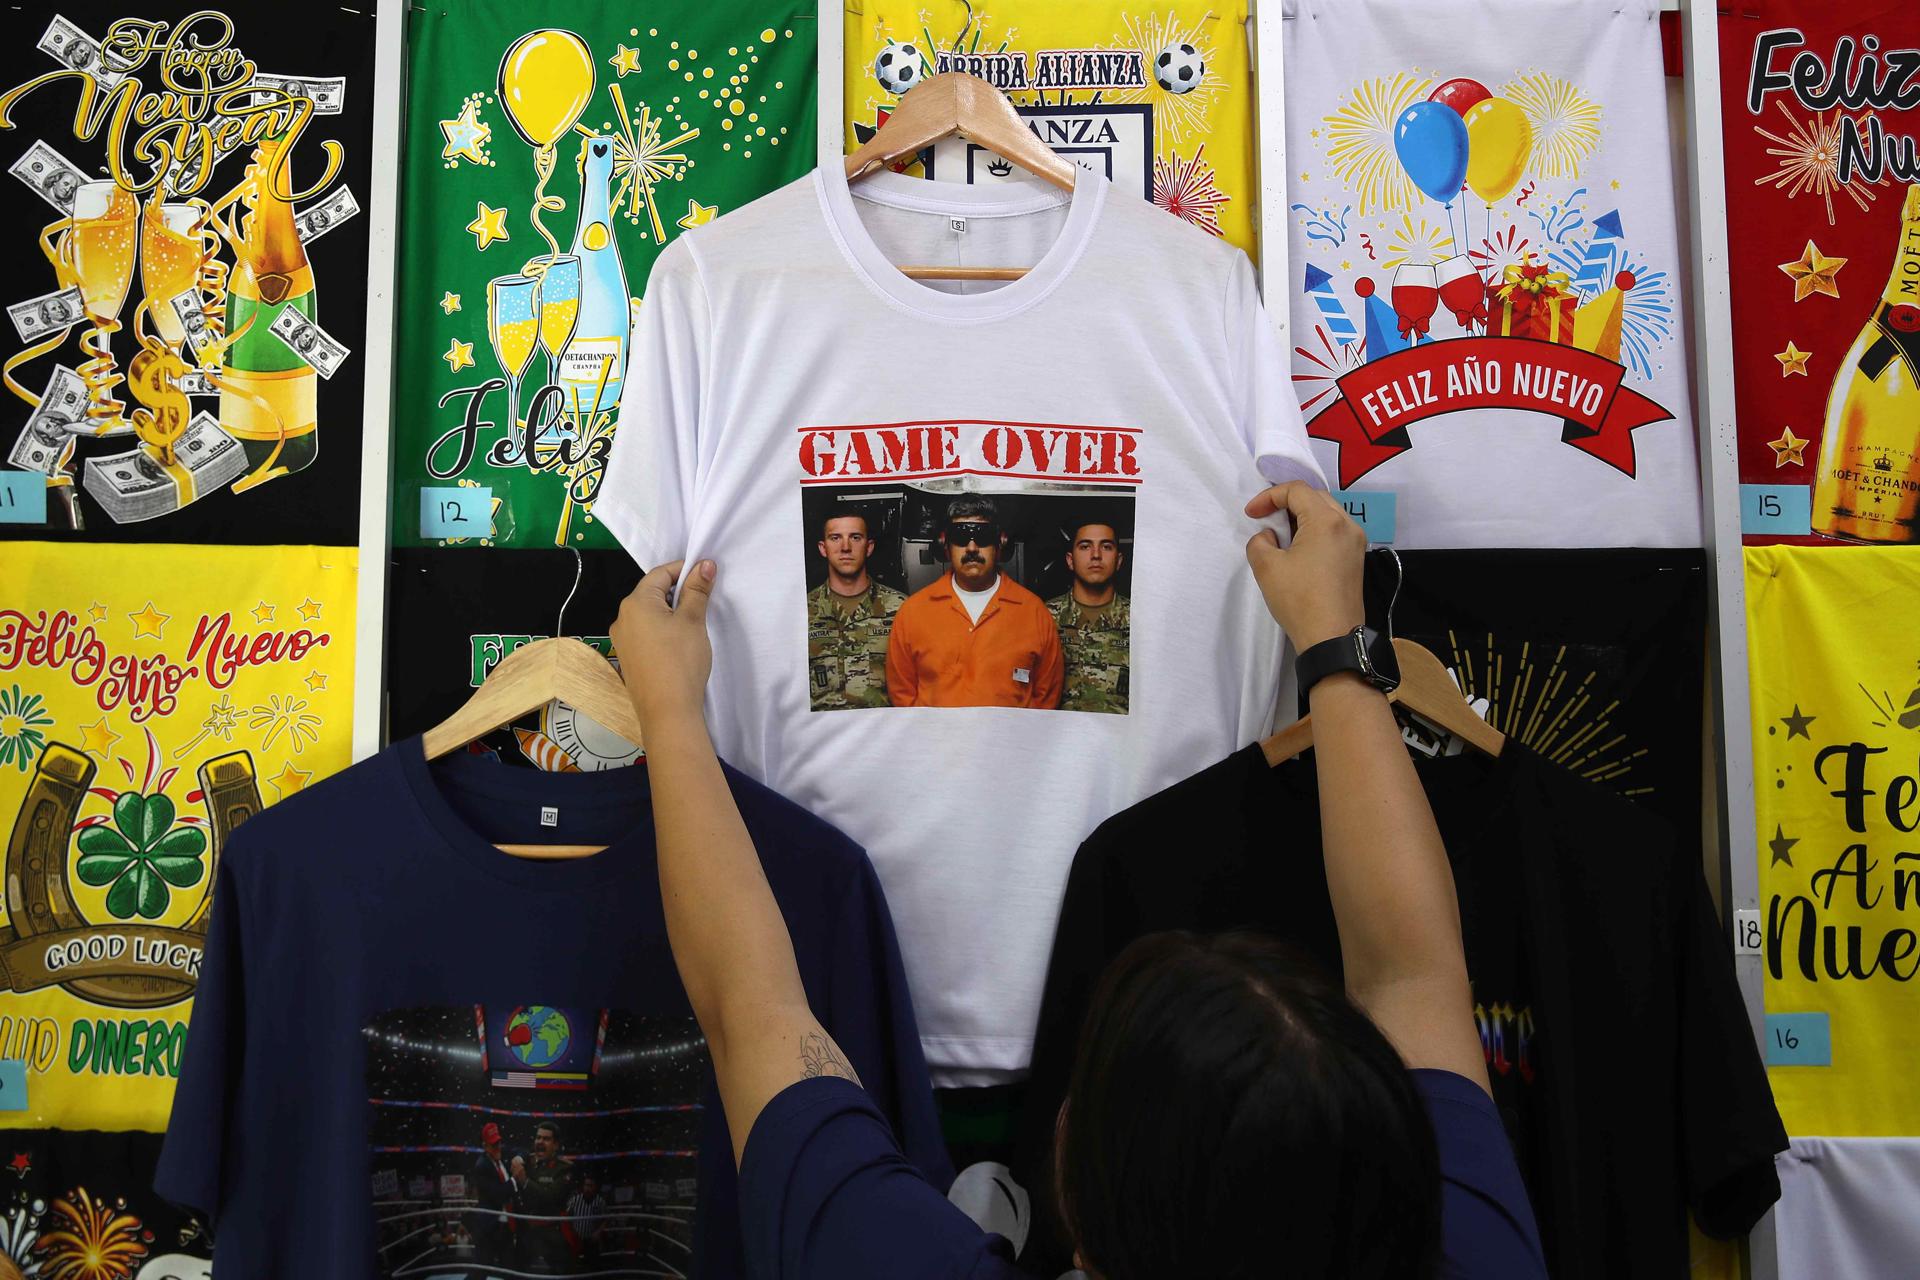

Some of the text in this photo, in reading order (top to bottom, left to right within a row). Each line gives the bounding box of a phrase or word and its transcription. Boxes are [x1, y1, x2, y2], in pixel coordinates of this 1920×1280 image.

[102, 11, 244, 78] Happy
[1036, 54, 1145, 87] ALIANZA
[1748, 29, 1920, 114] Feliz
[135, 87, 345, 202] Year
[1361, 355, 1605, 427] FELIZ AÑO NUEVO
[426, 379, 613, 505] Feliz
[799, 427, 1142, 477] GAME OVER
[1862, 475, 1870, 484] &
[440, 501, 468, 523] 12
[1758, 494, 1782, 517] 15
[1862, 511, 1886, 519] BRUT
[0, 610, 330, 722] Feliz Año Nuevo
[47, 936, 204, 977] GOOD LUCK
[1739, 919, 1762, 949] 18
[68, 1018, 189, 1078] DINERO
[1776, 1027, 1799, 1049] 16
